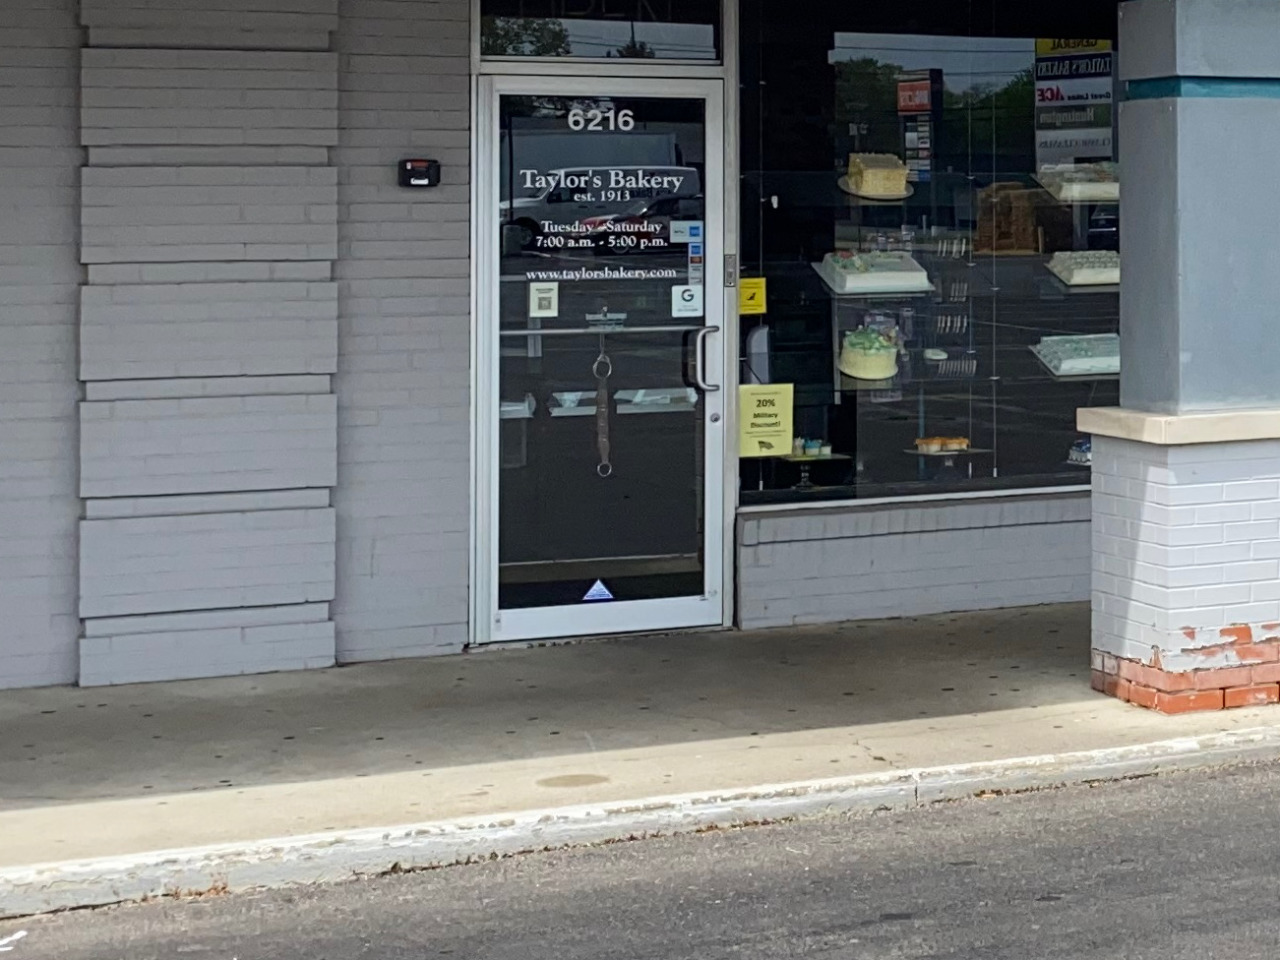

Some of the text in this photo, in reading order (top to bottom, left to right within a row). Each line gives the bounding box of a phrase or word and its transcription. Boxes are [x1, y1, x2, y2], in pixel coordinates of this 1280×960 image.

[567, 109, 635, 132] 6216
[519, 169, 602, 194] Taylor's
[608, 168, 684, 193] Bakery
[573, 191, 596, 203] est.
[600, 190, 631, 203] 1913
[540, 220, 593, 236] Tuesday
[606, 220, 662, 235] Saturday
[535, 235, 564, 248] 7:00
[567, 238, 595, 248] a.m.
[608, 235, 637, 248] 5:00
[640, 237, 668, 250] p.m.
[526, 266, 677, 282] www.taylorsbakery.com
[756, 398, 776, 408] 20%
